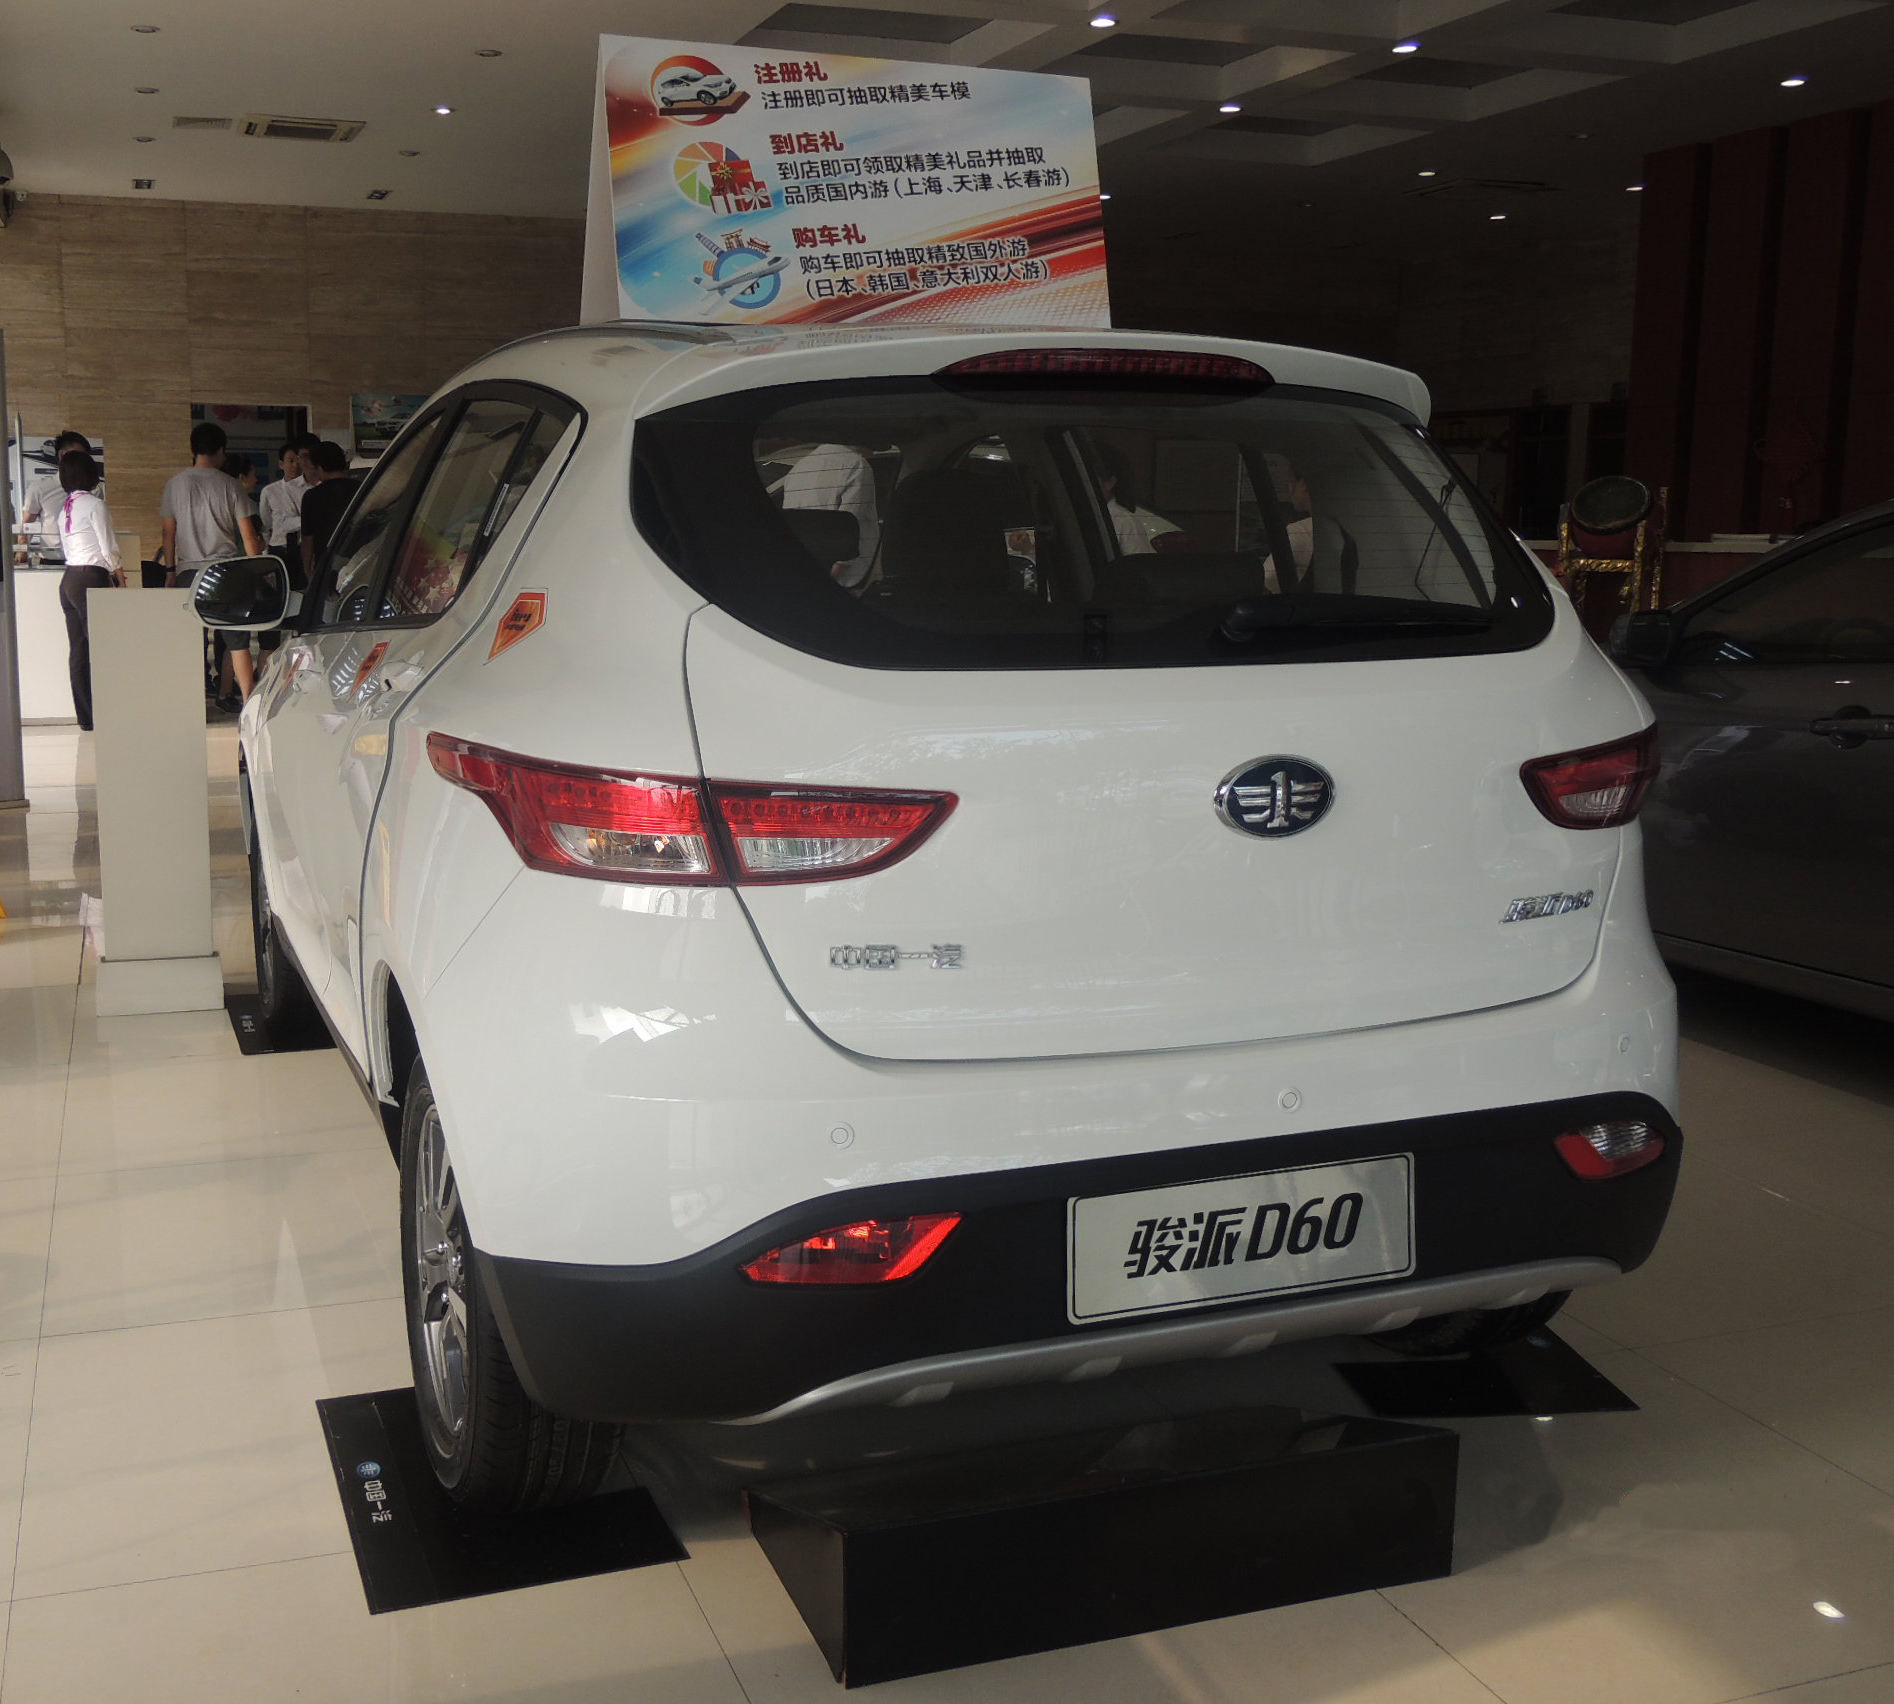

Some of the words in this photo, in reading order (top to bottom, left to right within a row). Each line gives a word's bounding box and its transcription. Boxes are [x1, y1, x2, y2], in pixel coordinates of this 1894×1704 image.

[754, 60, 828, 85] 注册礼
[761, 81, 971, 111] 注册即可抽取精美车模
[769, 131, 844, 156] 到店礼
[777, 145, 1046, 181] 到店即可领取精美礼品并抽取
[792, 222, 867, 249] 购车礼
[799, 239, 1028, 275] 购车即可抽取精致国外游
[829, 943, 965, 970] 中国一汽
[1123, 1192, 1365, 1279] 骏派D60
